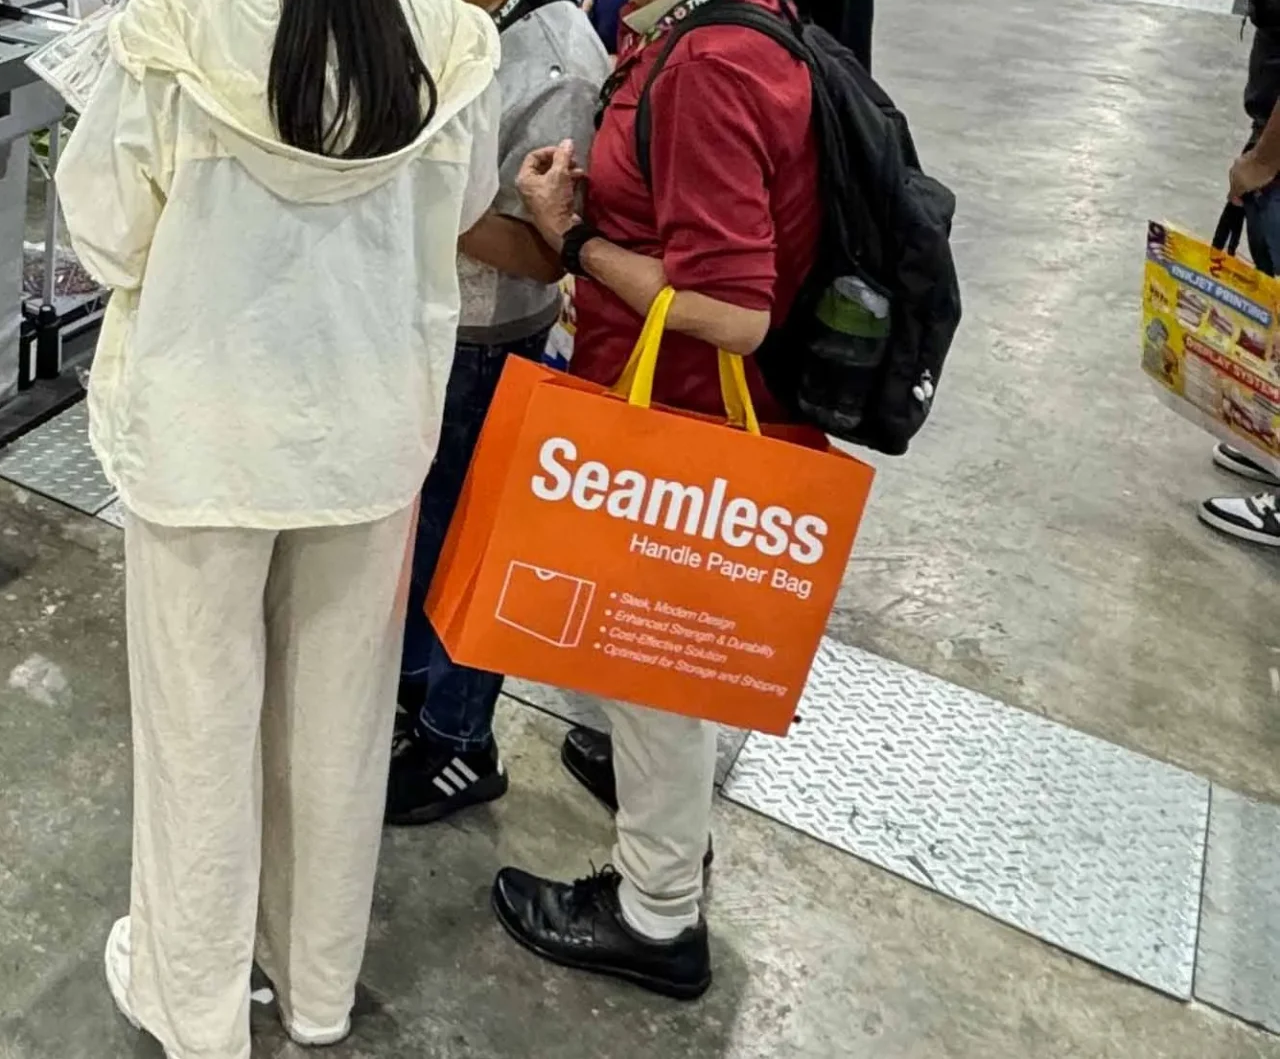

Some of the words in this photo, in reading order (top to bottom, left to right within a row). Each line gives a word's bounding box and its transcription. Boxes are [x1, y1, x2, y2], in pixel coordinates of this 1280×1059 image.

[531, 437, 828, 564] Seamless
[630, 534, 702, 568] Handle
[706, 553, 767, 587] Paper
[771, 568, 813, 600] Bag
[614, 610, 669, 632] Enhanced
[669, 623, 717, 644] Strength
[727, 637, 776, 659] Durability
[654, 600, 698, 620] Modern
[698, 612, 737, 630] Design
[604, 643, 658, 666] Optimized
[658, 655, 674, 669] for
[674, 659, 718, 680] Storage
[718, 672, 742, 684] and
[741, 674, 788, 697] Shipping
[609, 627, 683, 653] Cost-Effective
[684, 644, 728, 664] Solution
